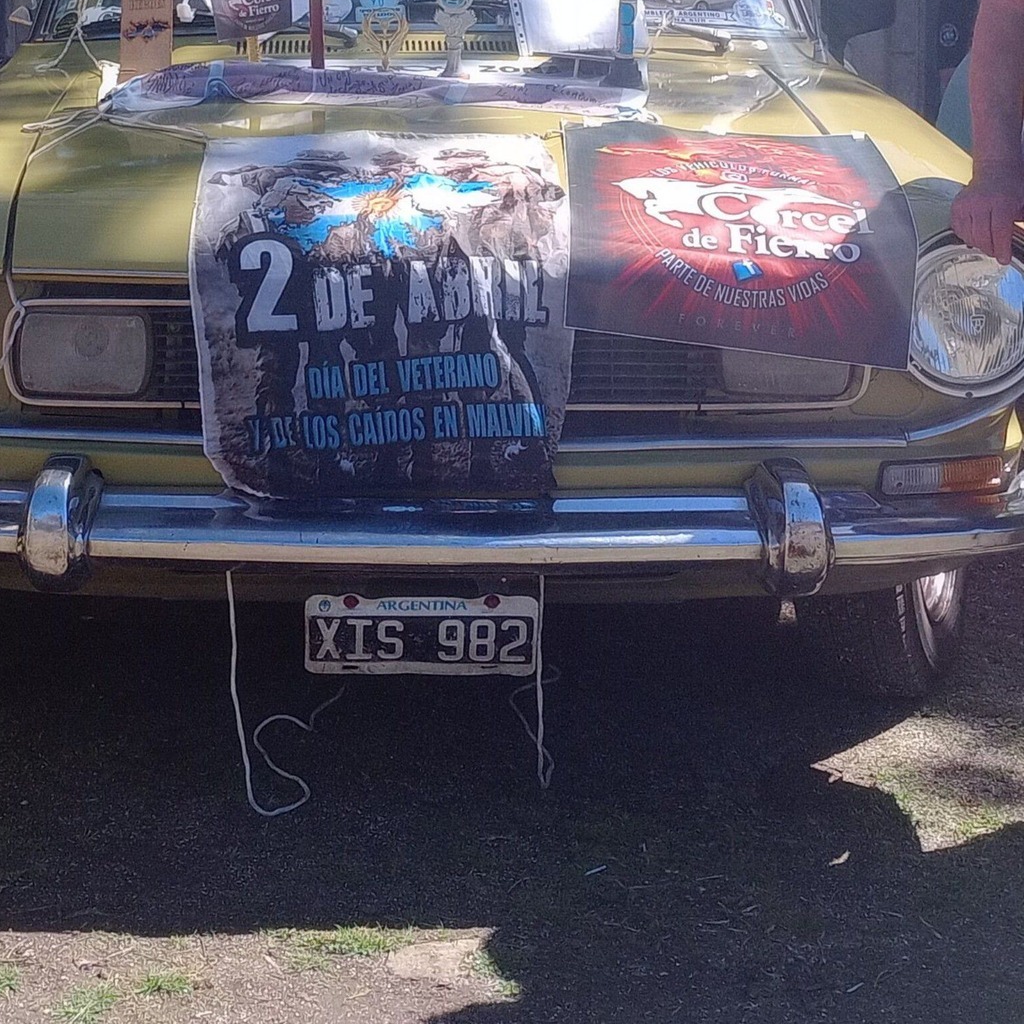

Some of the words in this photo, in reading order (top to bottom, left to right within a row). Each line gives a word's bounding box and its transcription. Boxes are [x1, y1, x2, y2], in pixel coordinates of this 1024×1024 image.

[248, 4, 280, 17] Fierro
[699, 192, 874, 234] Corcel
[682, 228, 718, 250] de
[725, 224, 861, 263] Fierro
[240, 239, 298, 332] 2
[313, 263, 376, 331] DE
[408, 255, 547, 324] ABRIL
[655, 248, 697, 285] PARTE
[694, 274, 715, 297] DE
[714, 284, 786, 309] NUESTRAS
[788, 272, 829, 302] VIDAS
[678, 313, 796, 338] FOREVER
[308, 361, 346, 398] DÍA
[353, 361, 390, 397] DEL
[396, 353, 499, 393] VETERANO
[271, 416, 297, 448] DE
[303, 415, 341, 450] LOS
[348, 406, 426, 446] CAÍDOS
[434, 405, 458, 439] EN
[376, 600, 468, 612] ARGENTINA
[316, 619, 404, 660] XIS
[437, 619, 527, 662] 982
